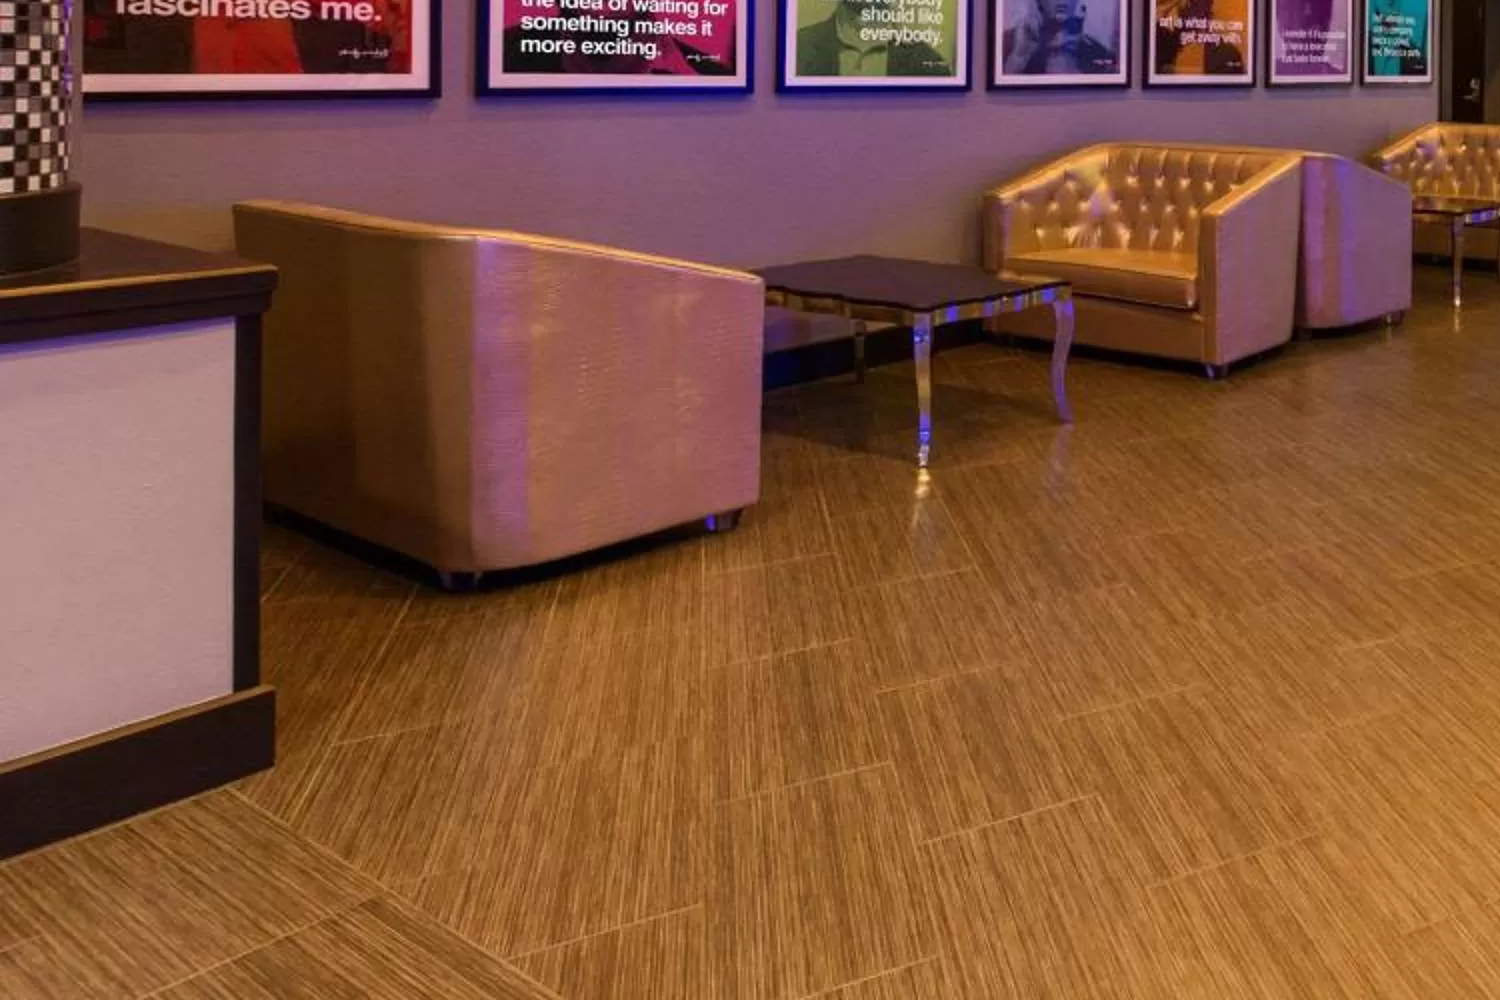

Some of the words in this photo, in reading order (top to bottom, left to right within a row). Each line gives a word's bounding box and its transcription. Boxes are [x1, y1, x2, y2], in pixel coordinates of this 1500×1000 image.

[321, 0, 382, 21] me.
[703, 0, 728, 15] for
[860, 6, 914, 23] should
[918, 7, 944, 24] like
[520, 14, 629, 36] something
[635, 18, 696, 35] makes
[701, 19, 713, 36] it
[860, 26, 943, 48] everybody.
[520, 39, 576, 53] more
[581, 38, 662, 60] exciting.
